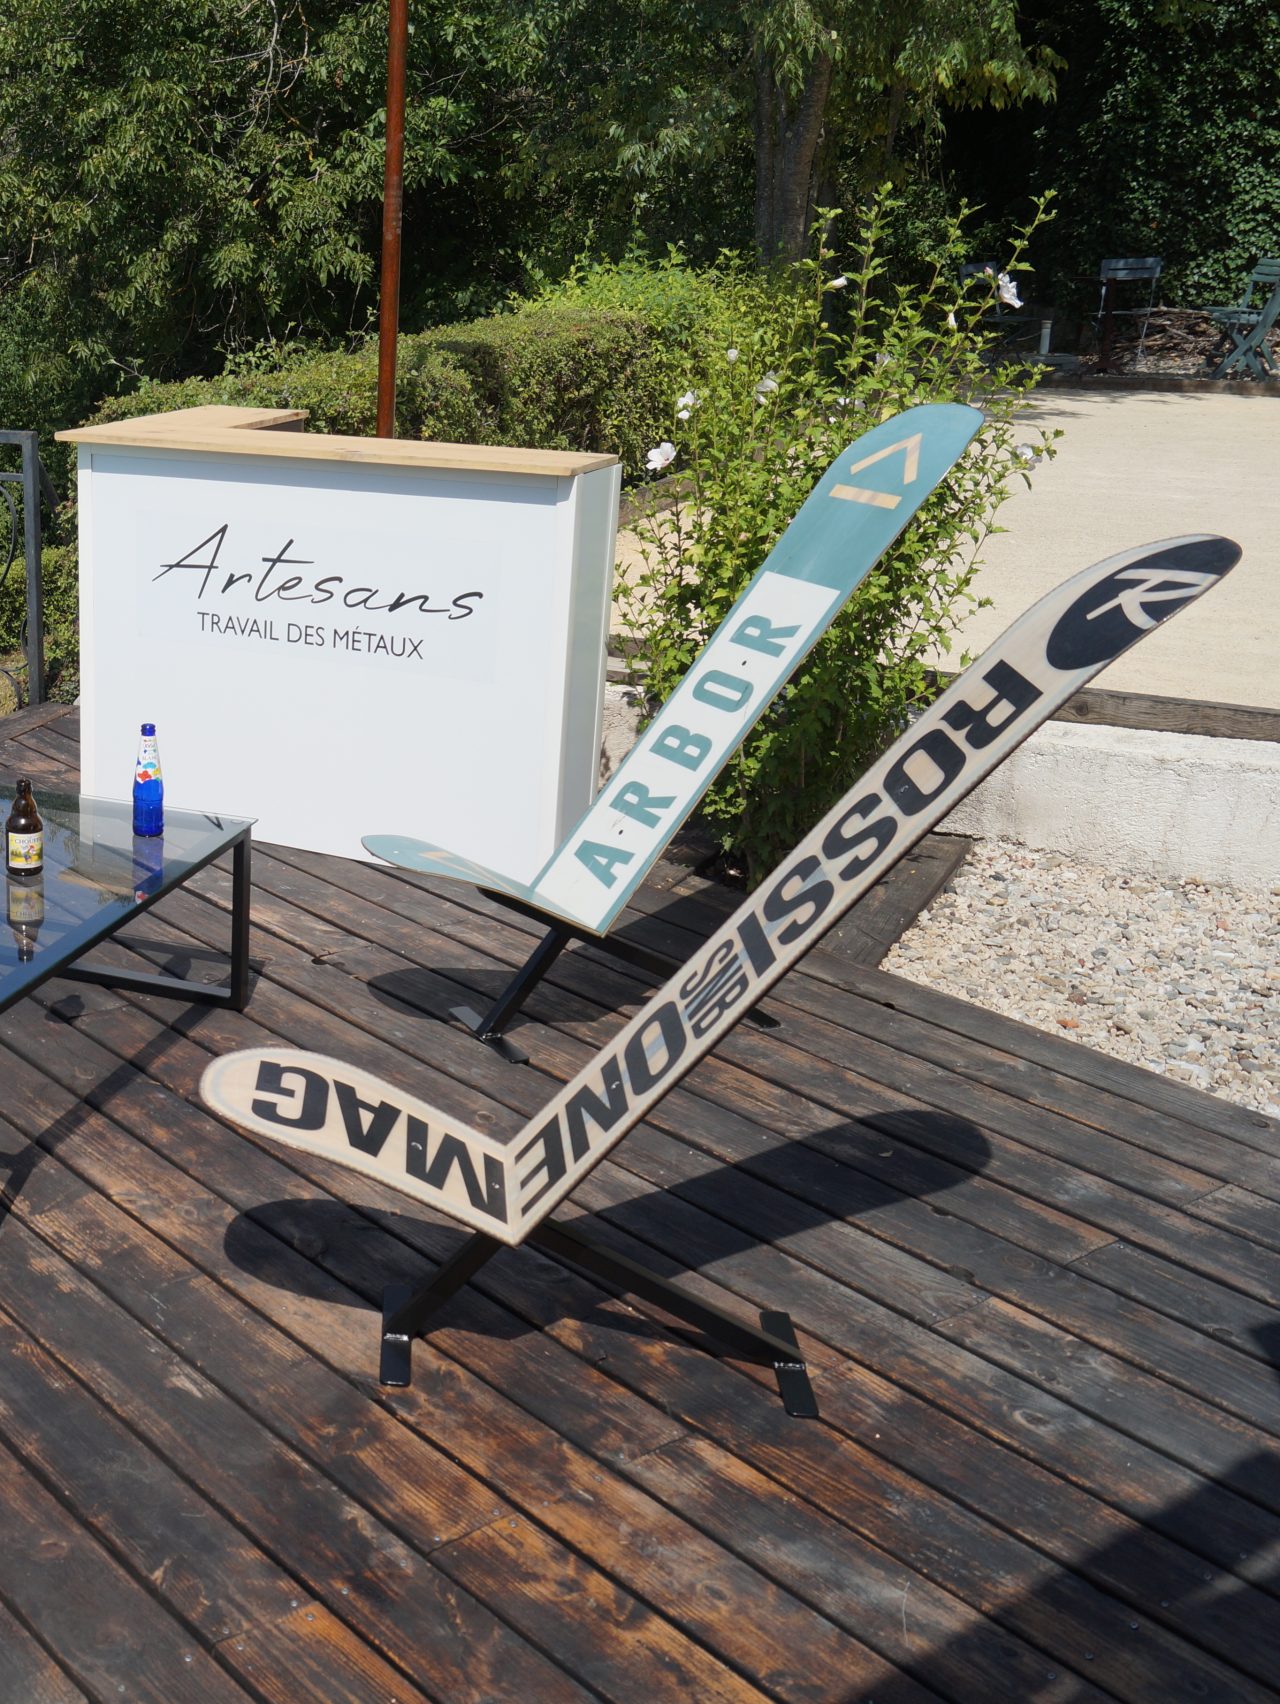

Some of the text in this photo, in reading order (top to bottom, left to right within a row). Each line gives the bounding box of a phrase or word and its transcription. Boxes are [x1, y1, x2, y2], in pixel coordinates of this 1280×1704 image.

[152, 523, 483, 621] Artesans
[197, 611, 424, 660] TRAVAIL DES MÉTAUX
[737, 659, 1044, 978] ROSSI
[251, 1000, 687, 1224] ONE MAG
